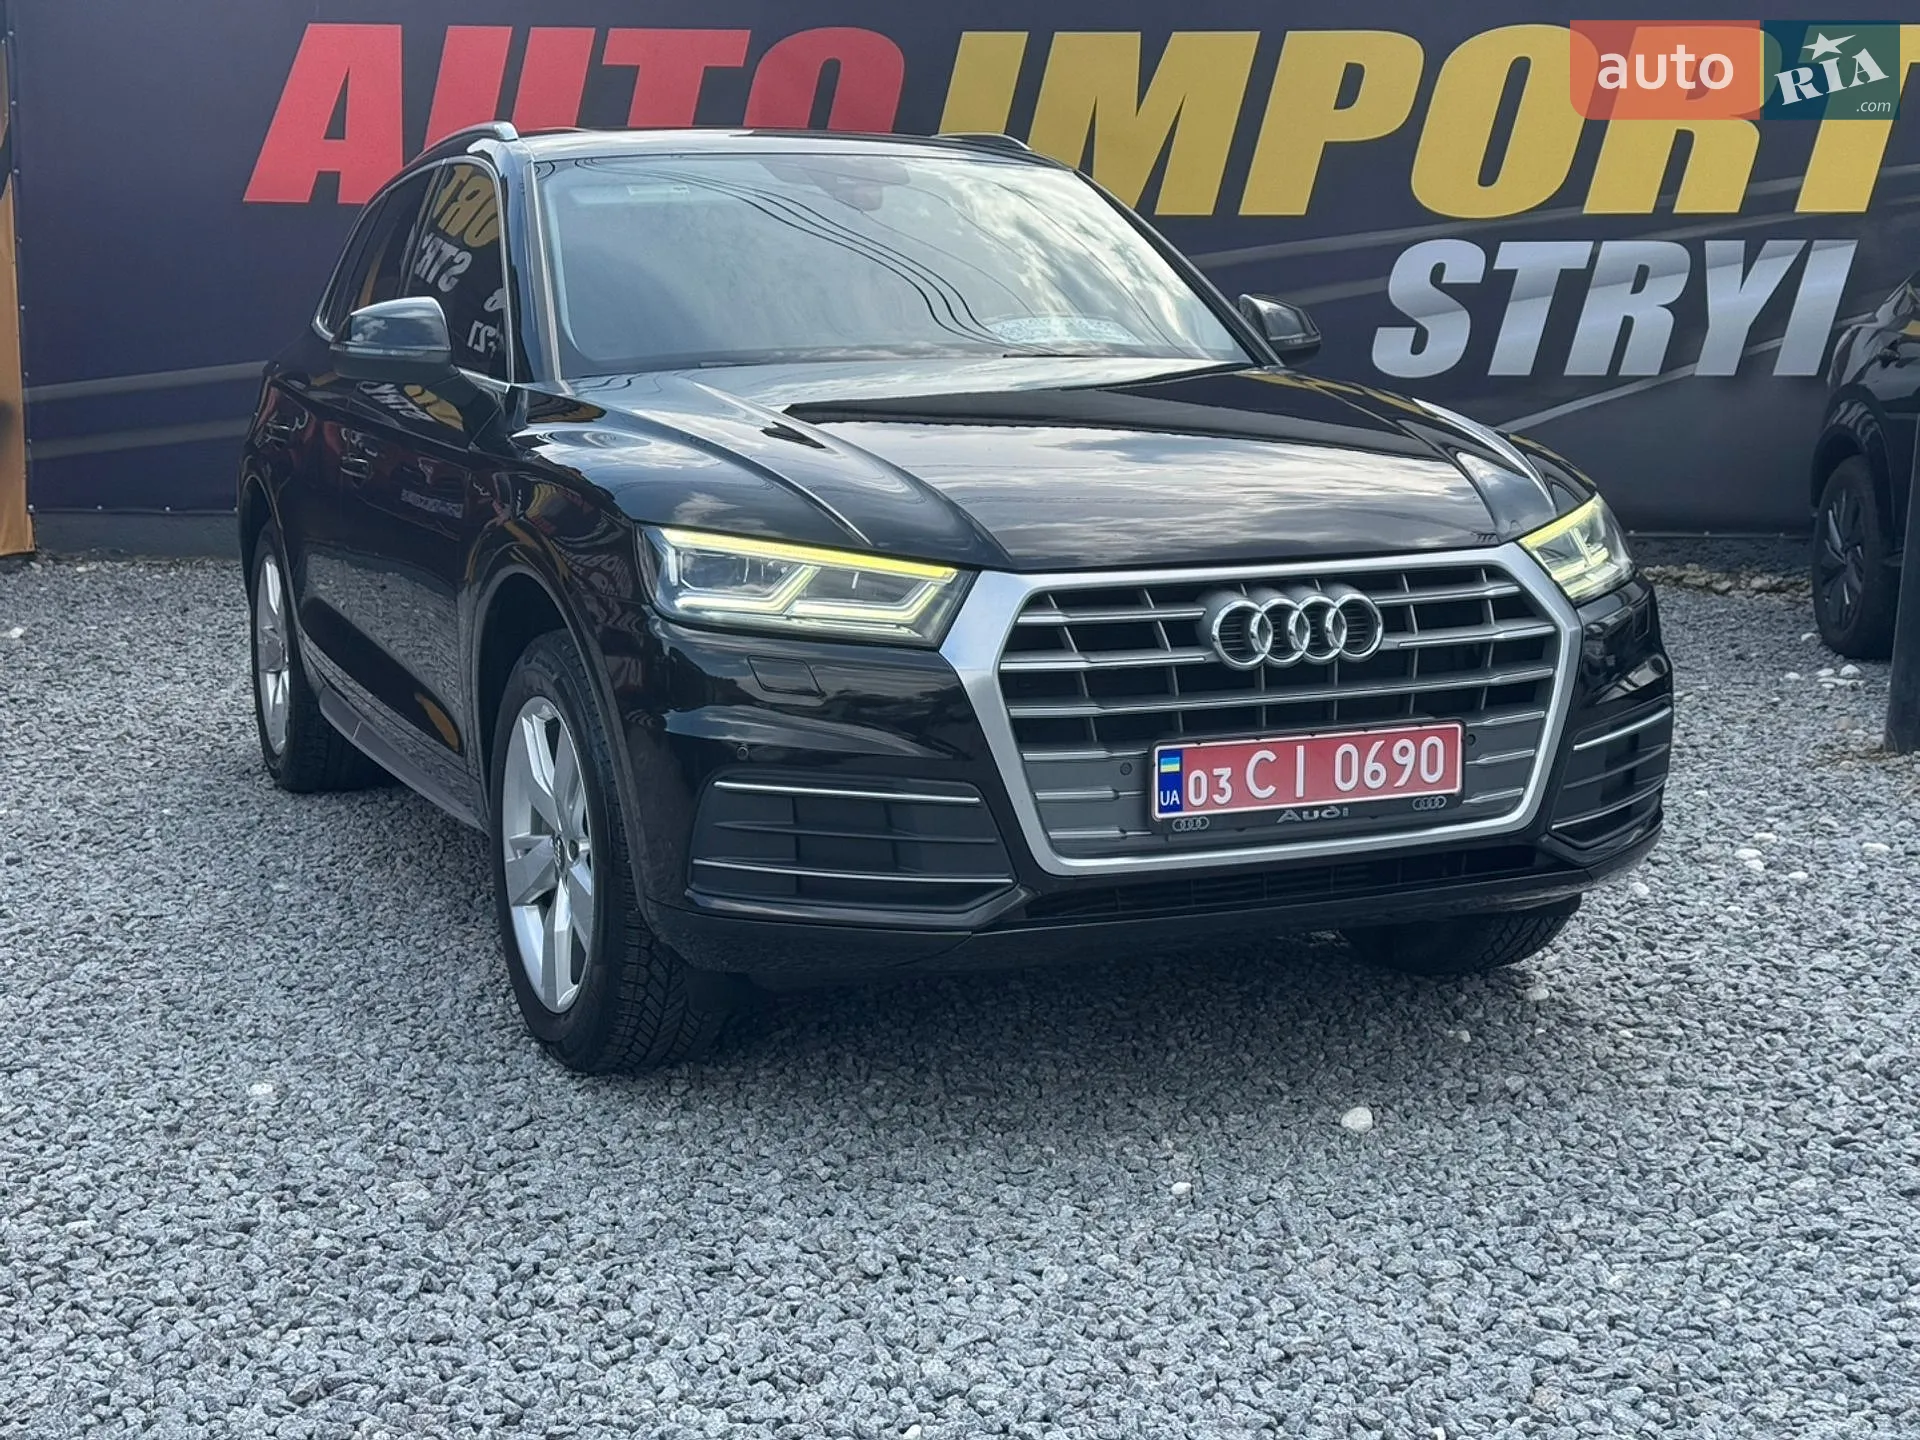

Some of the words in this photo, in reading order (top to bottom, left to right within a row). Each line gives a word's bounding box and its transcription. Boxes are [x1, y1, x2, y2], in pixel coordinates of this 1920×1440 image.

[243, 23, 905, 204] AUTO
[939, 24, 1920, 219] IMPORT
[1372, 239, 1859, 379] STRYI
[1160, 790, 1180, 807] UA
[1187, 767, 1233, 807] 03
[1334, 736, 1445, 792] 0690
[1276, 805, 1350, 824] Audi
